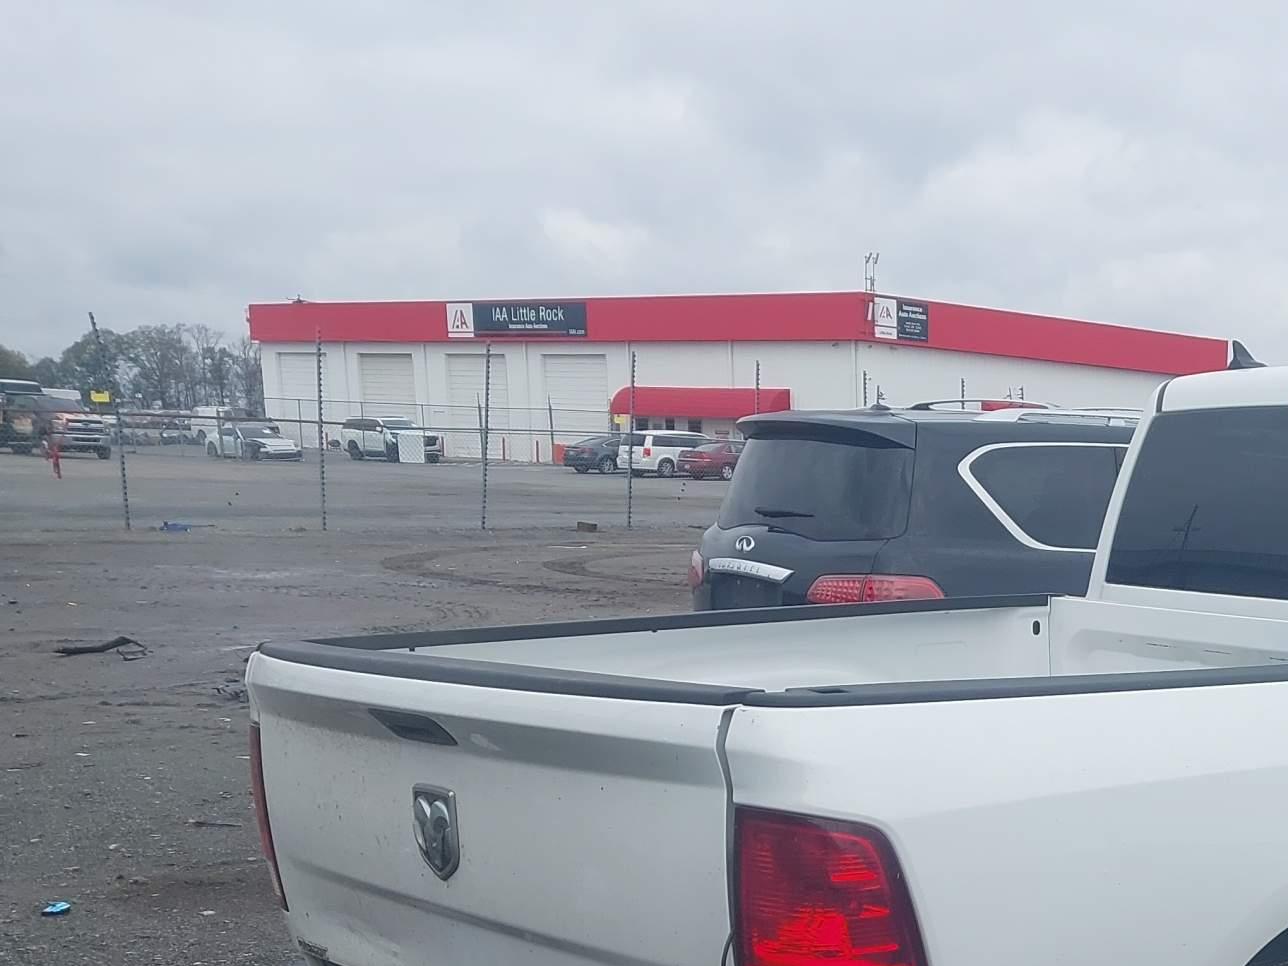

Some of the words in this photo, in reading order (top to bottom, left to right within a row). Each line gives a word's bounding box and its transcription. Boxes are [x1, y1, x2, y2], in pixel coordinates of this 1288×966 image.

[492, 306, 508, 321] IAA
[511, 306, 536, 321] Little
[540, 305, 565, 321] Rock
